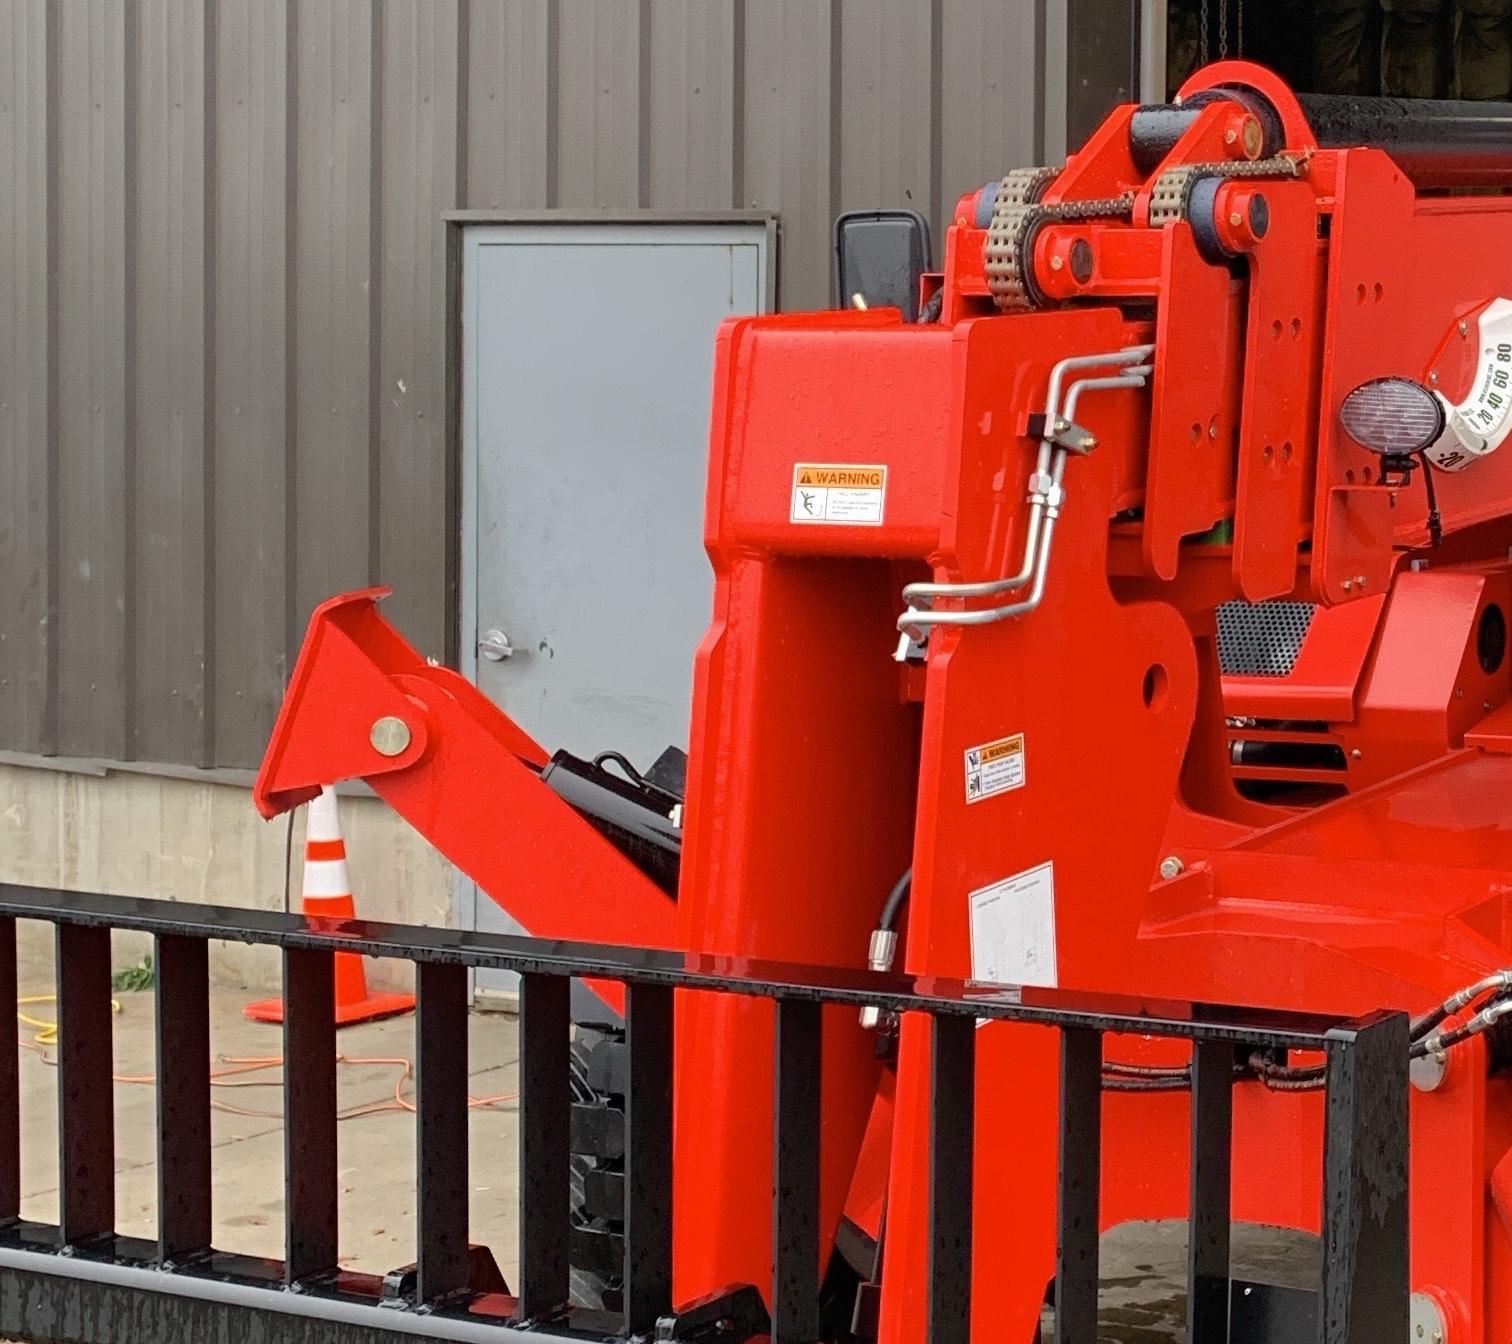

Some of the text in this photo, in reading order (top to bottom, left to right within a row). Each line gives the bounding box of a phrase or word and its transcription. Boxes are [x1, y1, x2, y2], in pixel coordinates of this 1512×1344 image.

[1497, 343, 1512, 363] 80
[1493, 369, 1510, 389] 60
[1487, 392, 1504, 410] 40
[1477, 409, 1494, 426] 20
[816, 472, 880, 486] WARNING
